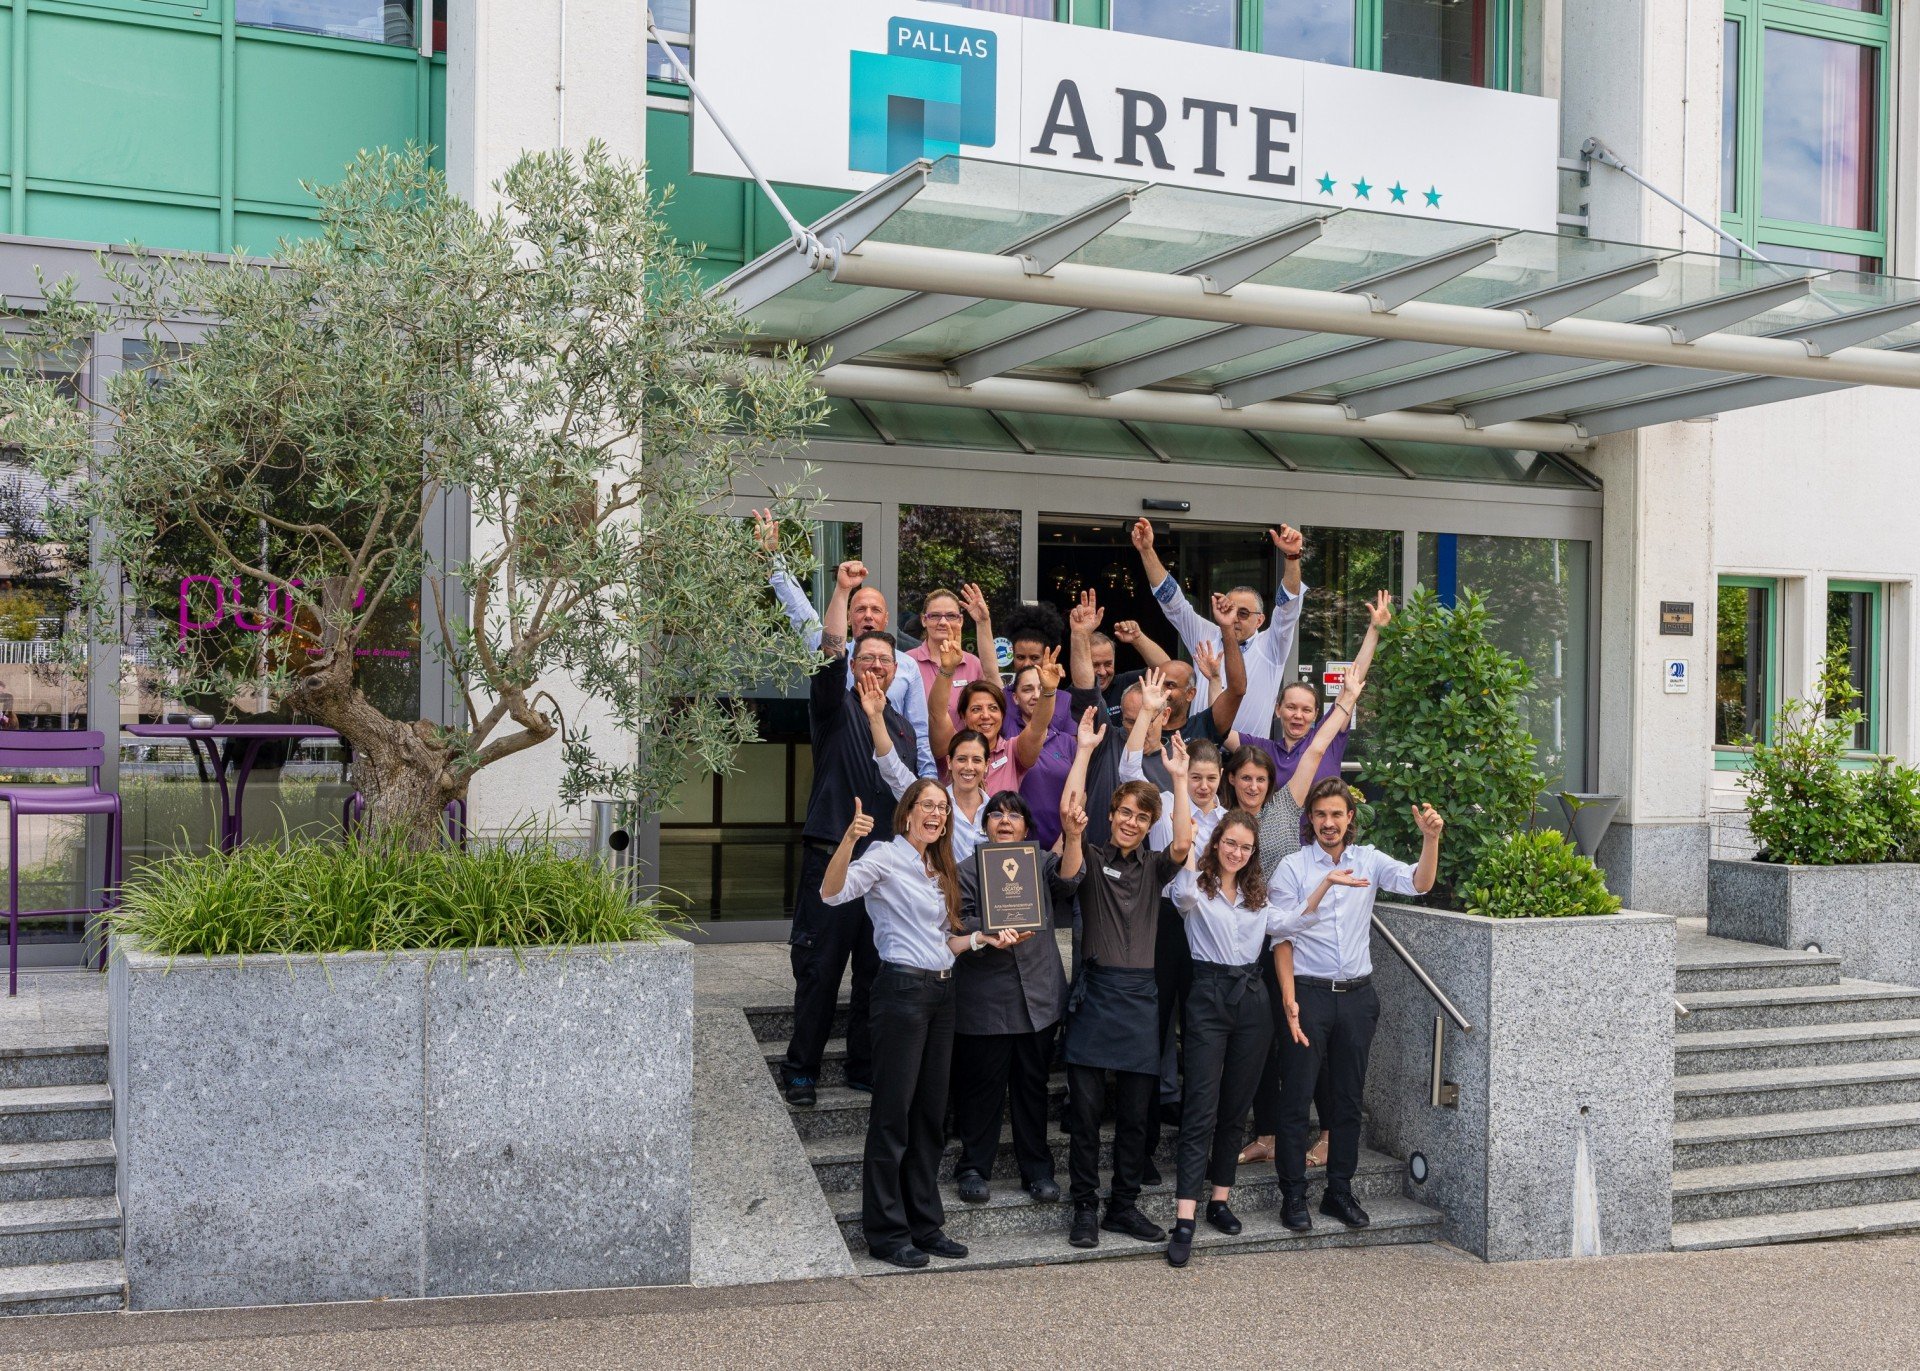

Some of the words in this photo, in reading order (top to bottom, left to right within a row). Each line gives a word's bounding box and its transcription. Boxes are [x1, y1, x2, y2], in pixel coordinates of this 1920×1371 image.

[898, 26, 988, 58] PALLAS
[1030, 79, 1297, 186] ARTE
[382, 649, 410, 659] lounge
